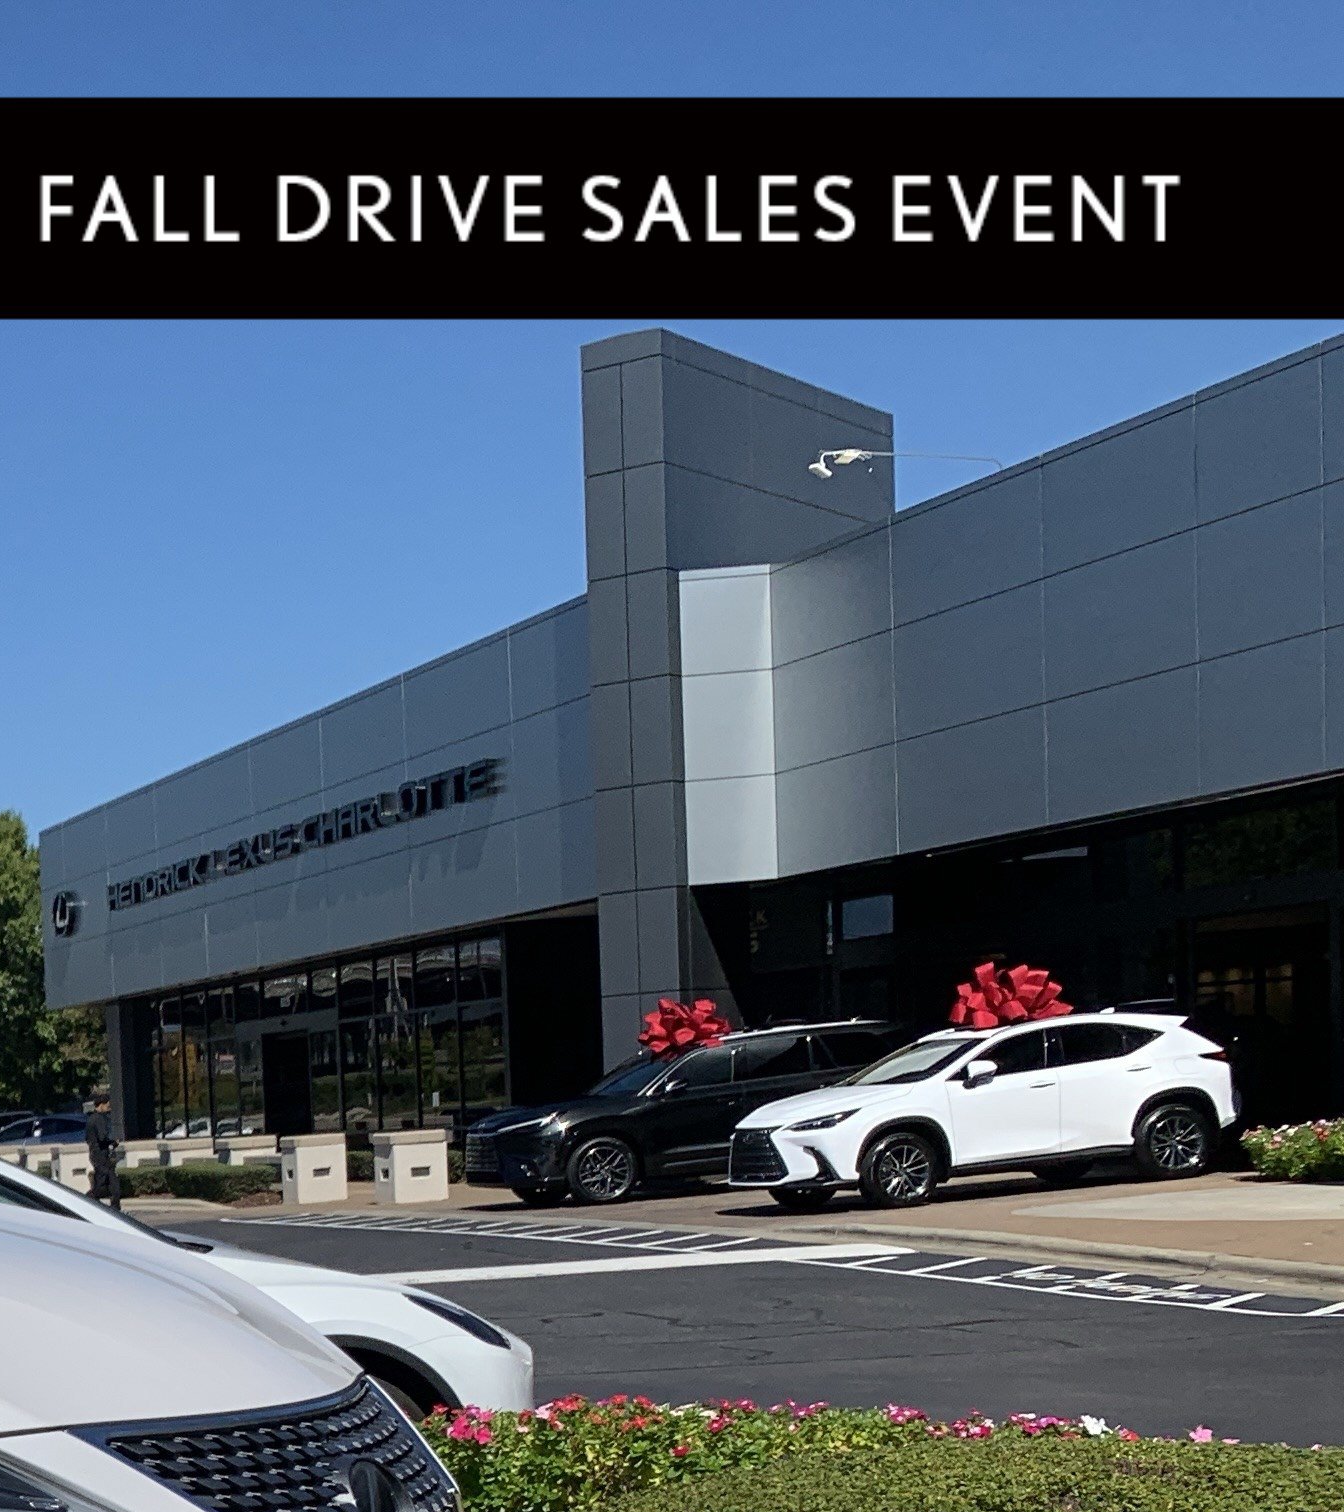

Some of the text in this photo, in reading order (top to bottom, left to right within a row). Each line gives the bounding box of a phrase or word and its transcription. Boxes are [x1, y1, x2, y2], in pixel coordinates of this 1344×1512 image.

[106, 757, 505, 911] HENDRICK LEXUS CHARLOTTE
